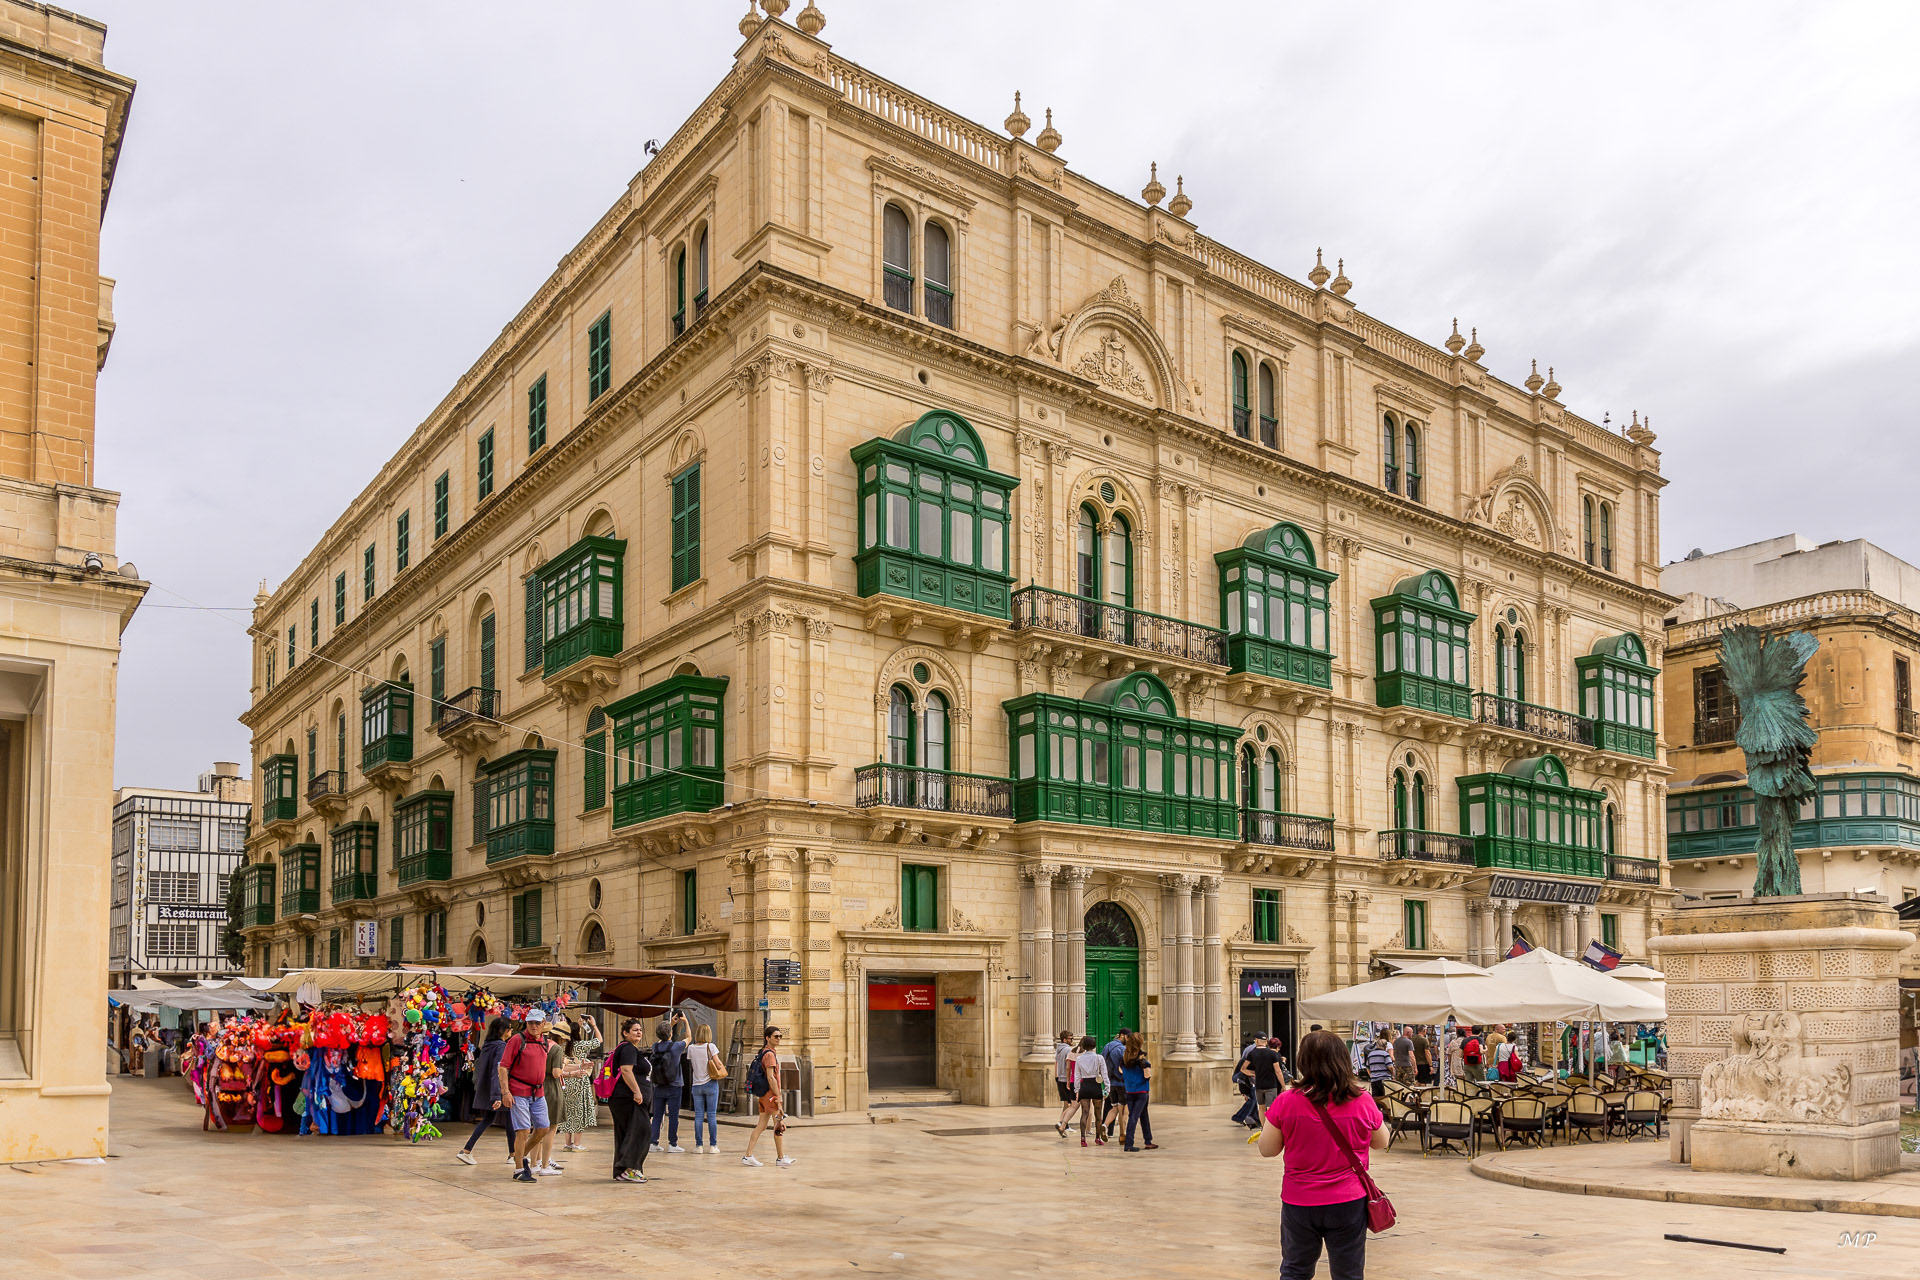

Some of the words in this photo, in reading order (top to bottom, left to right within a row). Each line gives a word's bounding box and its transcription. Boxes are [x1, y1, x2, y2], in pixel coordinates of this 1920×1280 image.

[135, 825, 146, 920] ORDNANCE
[1494, 878, 1517, 897] GIO.
[1519, 880, 1560, 900] BATTA
[1561, 885, 1598, 904] DELIA
[160, 906, 228, 919] Restaurant
[1261, 983, 1287, 993] melita
